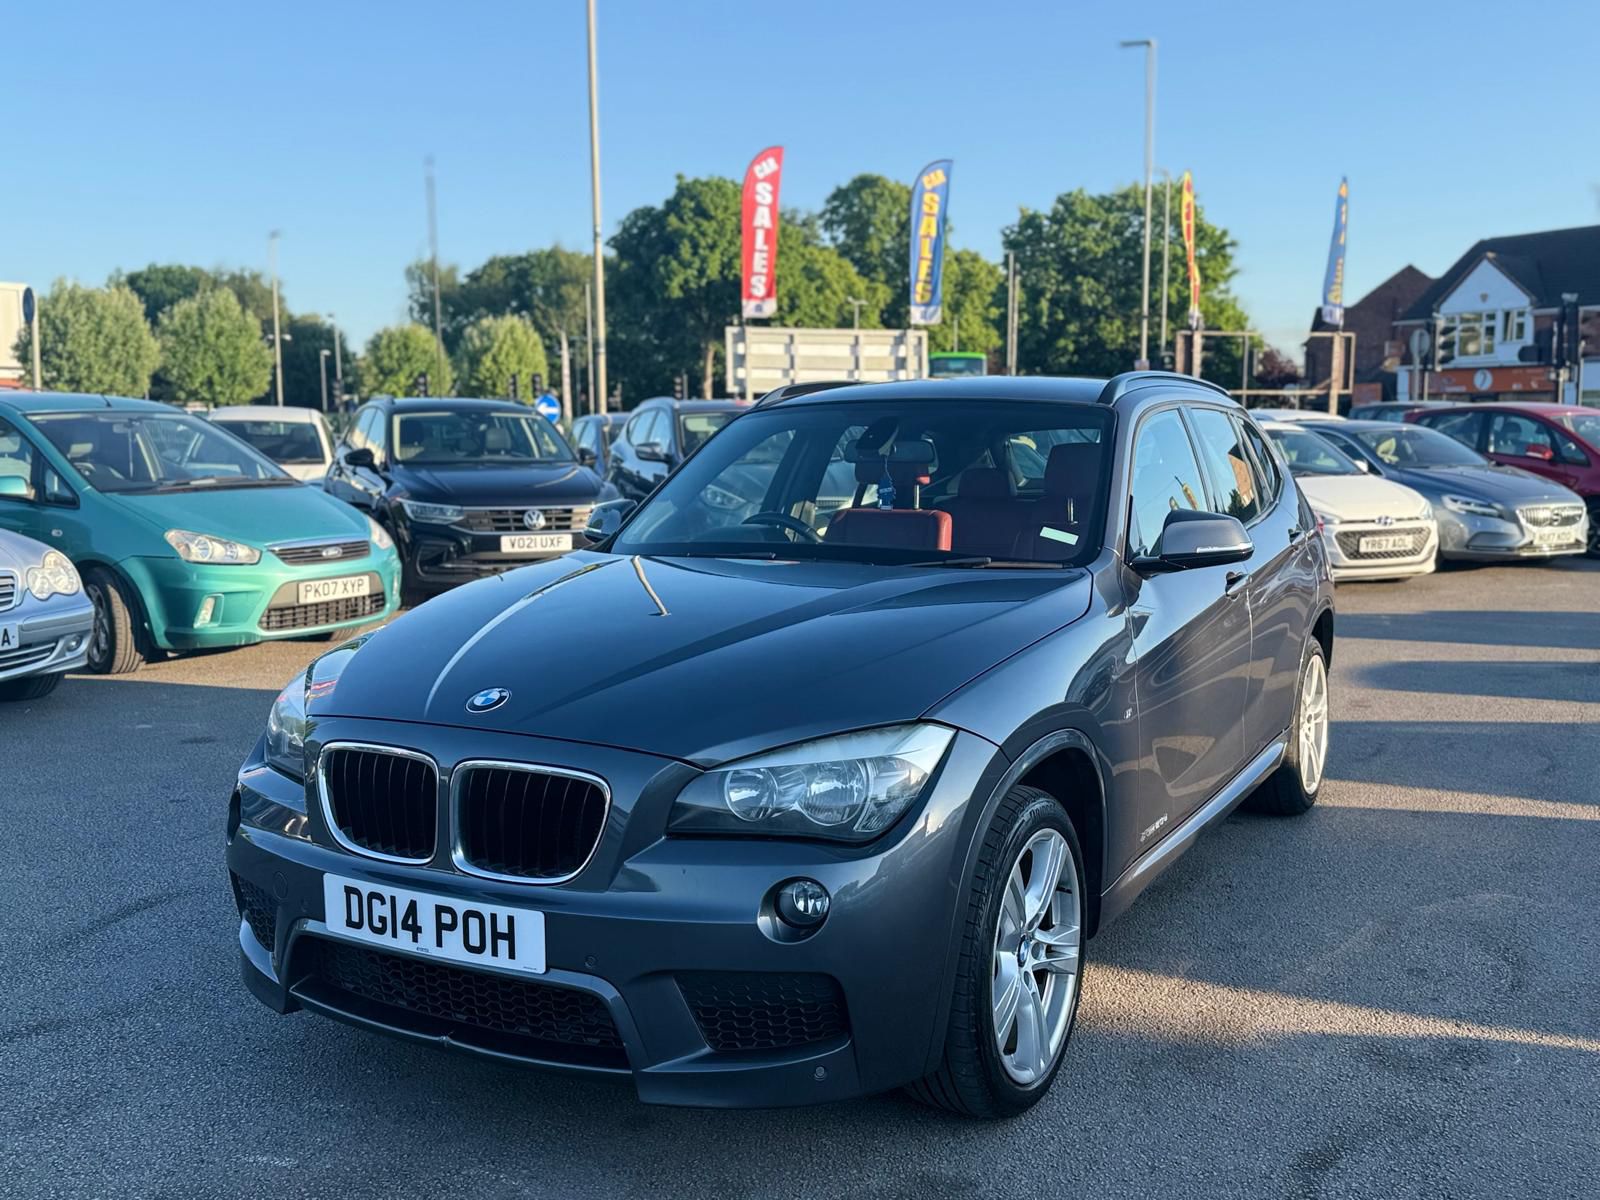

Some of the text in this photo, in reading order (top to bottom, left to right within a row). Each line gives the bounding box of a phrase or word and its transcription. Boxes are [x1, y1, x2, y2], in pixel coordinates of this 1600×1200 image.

[750, 181, 773, 298] SALES
[914, 192, 940, 305] SALES
[509, 536, 564, 549] VO21 UXF
[1364, 538, 1390, 550] YR67
[304, 578, 364, 599] PK07 XYP
[343, 884, 516, 961] DG14 POH
